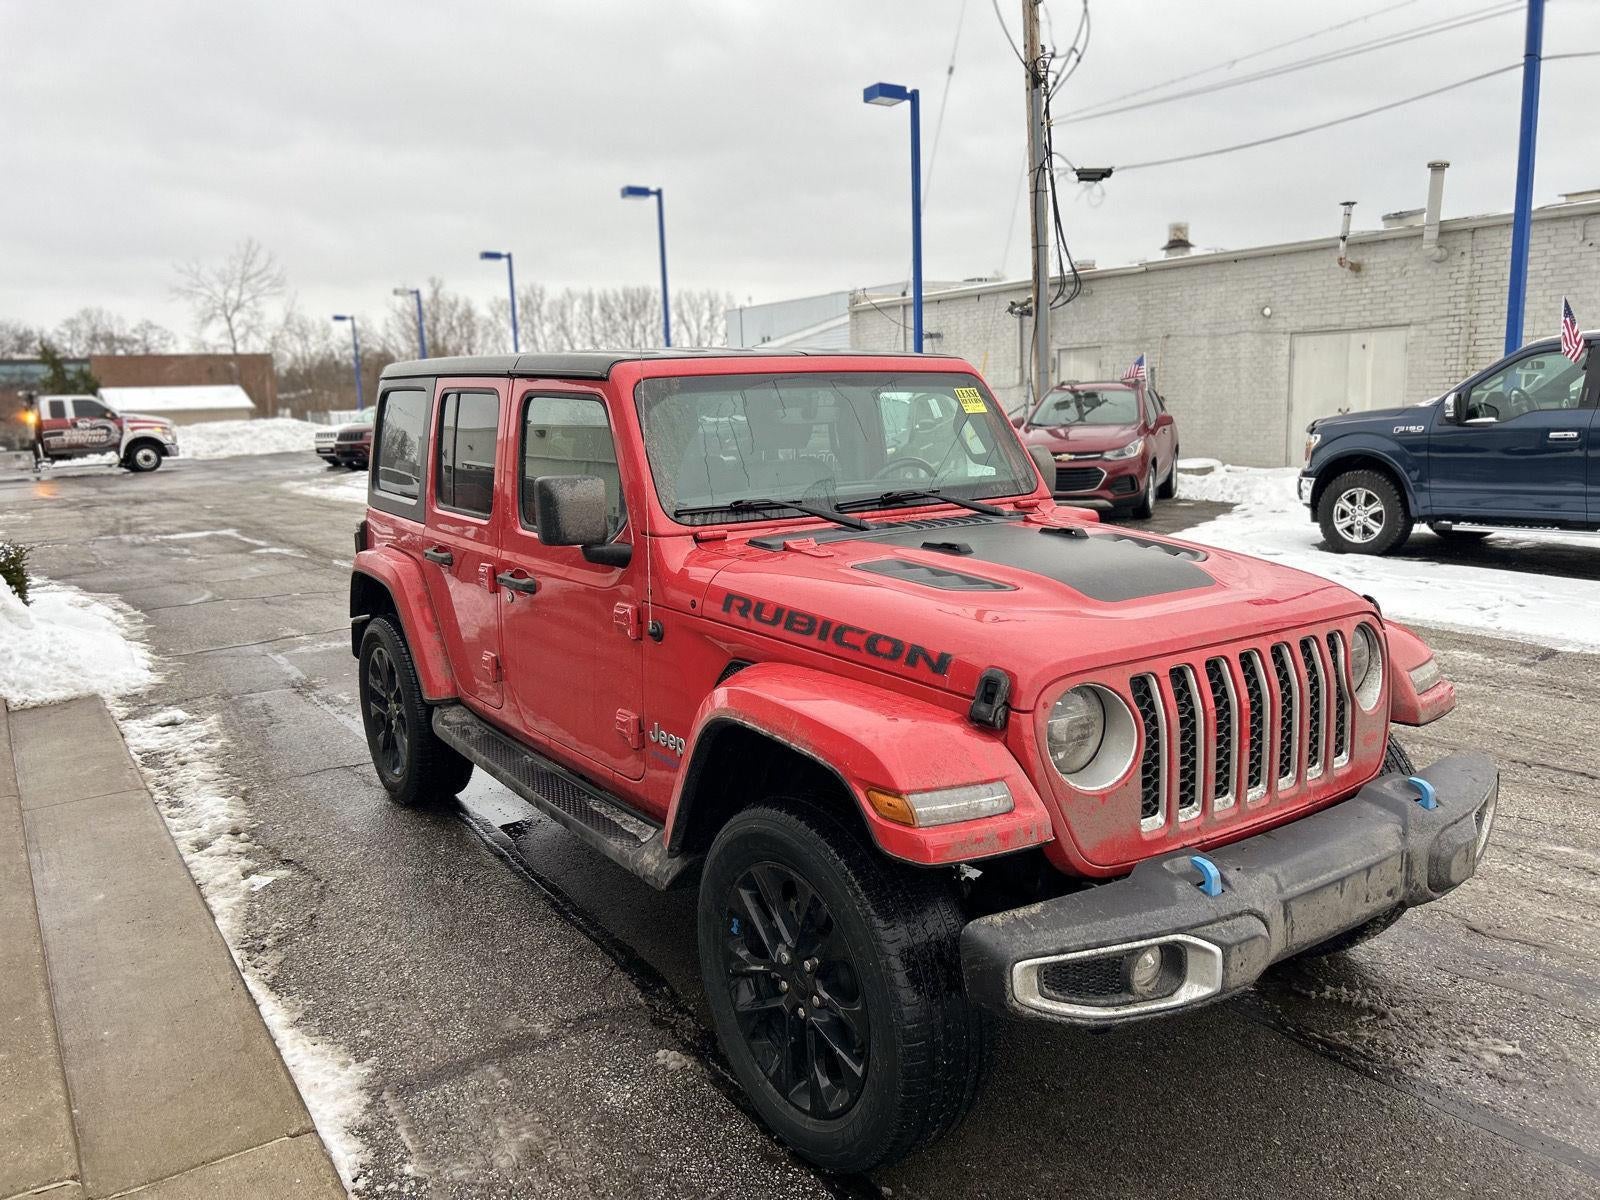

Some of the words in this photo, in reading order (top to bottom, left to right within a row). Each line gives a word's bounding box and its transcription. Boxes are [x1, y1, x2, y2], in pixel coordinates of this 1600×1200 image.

[956, 389, 980, 398] LEASE
[63, 434, 108, 444] TOWING
[722, 592, 953, 676] RUBICON
[649, 722, 686, 757] Jeep
